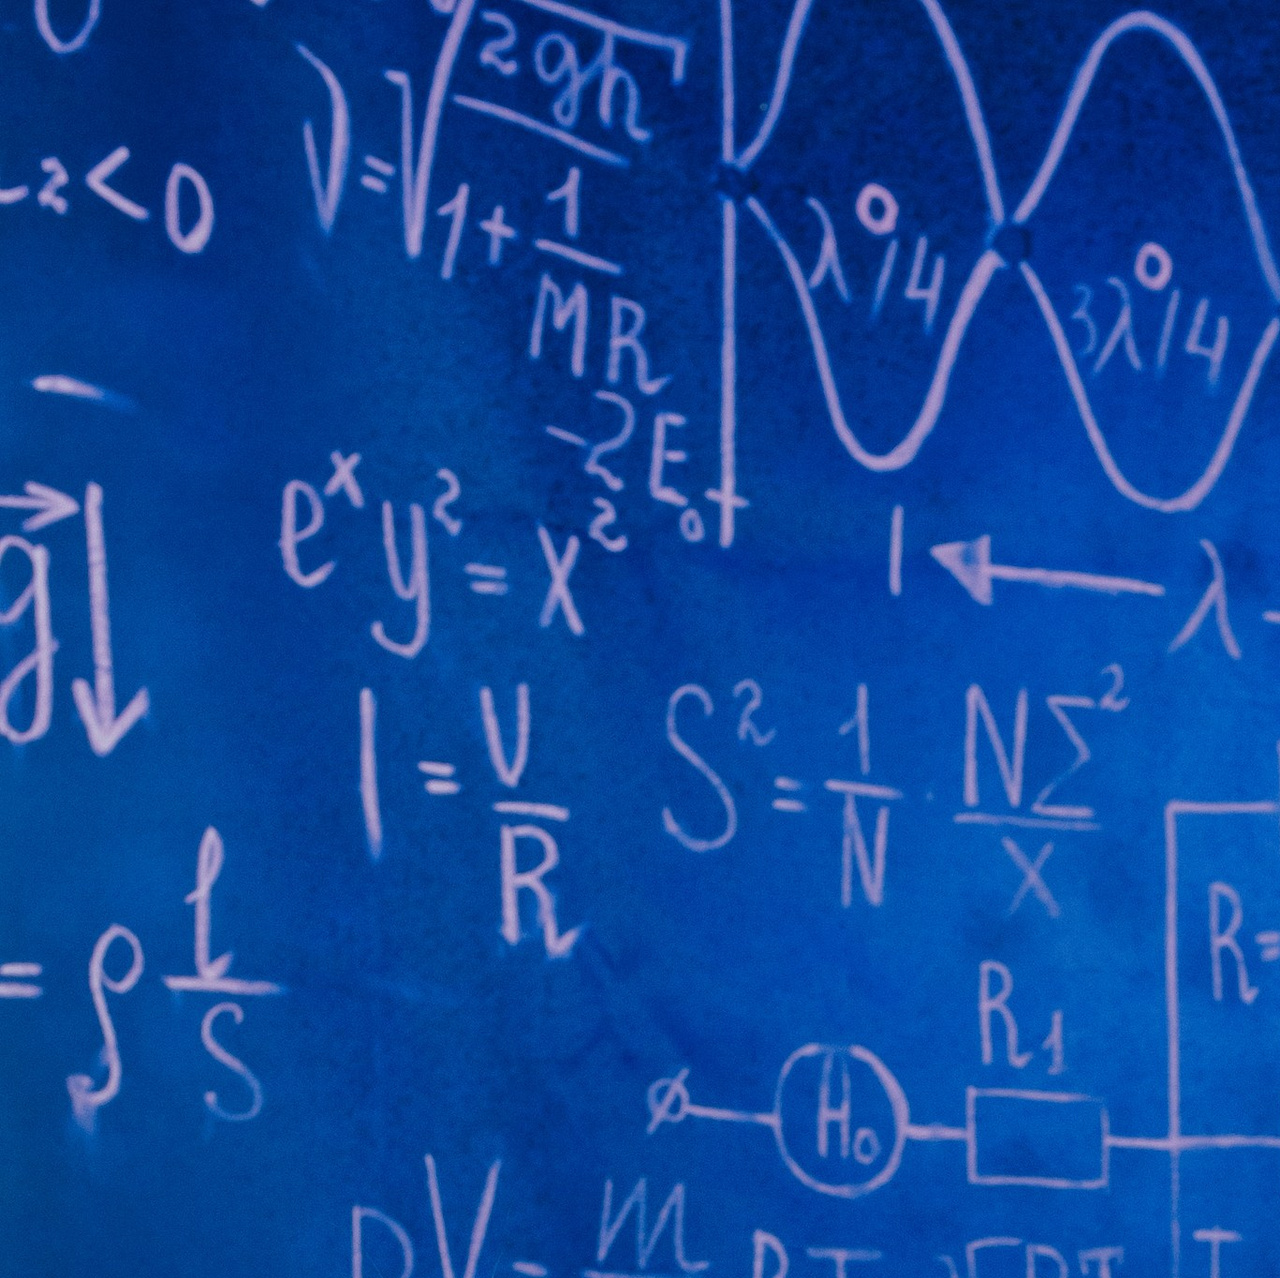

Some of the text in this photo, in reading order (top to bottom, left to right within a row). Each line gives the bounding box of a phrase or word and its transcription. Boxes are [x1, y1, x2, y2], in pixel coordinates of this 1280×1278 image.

[500, 823, 584, 960] R
[839, 803, 890, 909] N
[977, 958, 1066, 1077] R1
